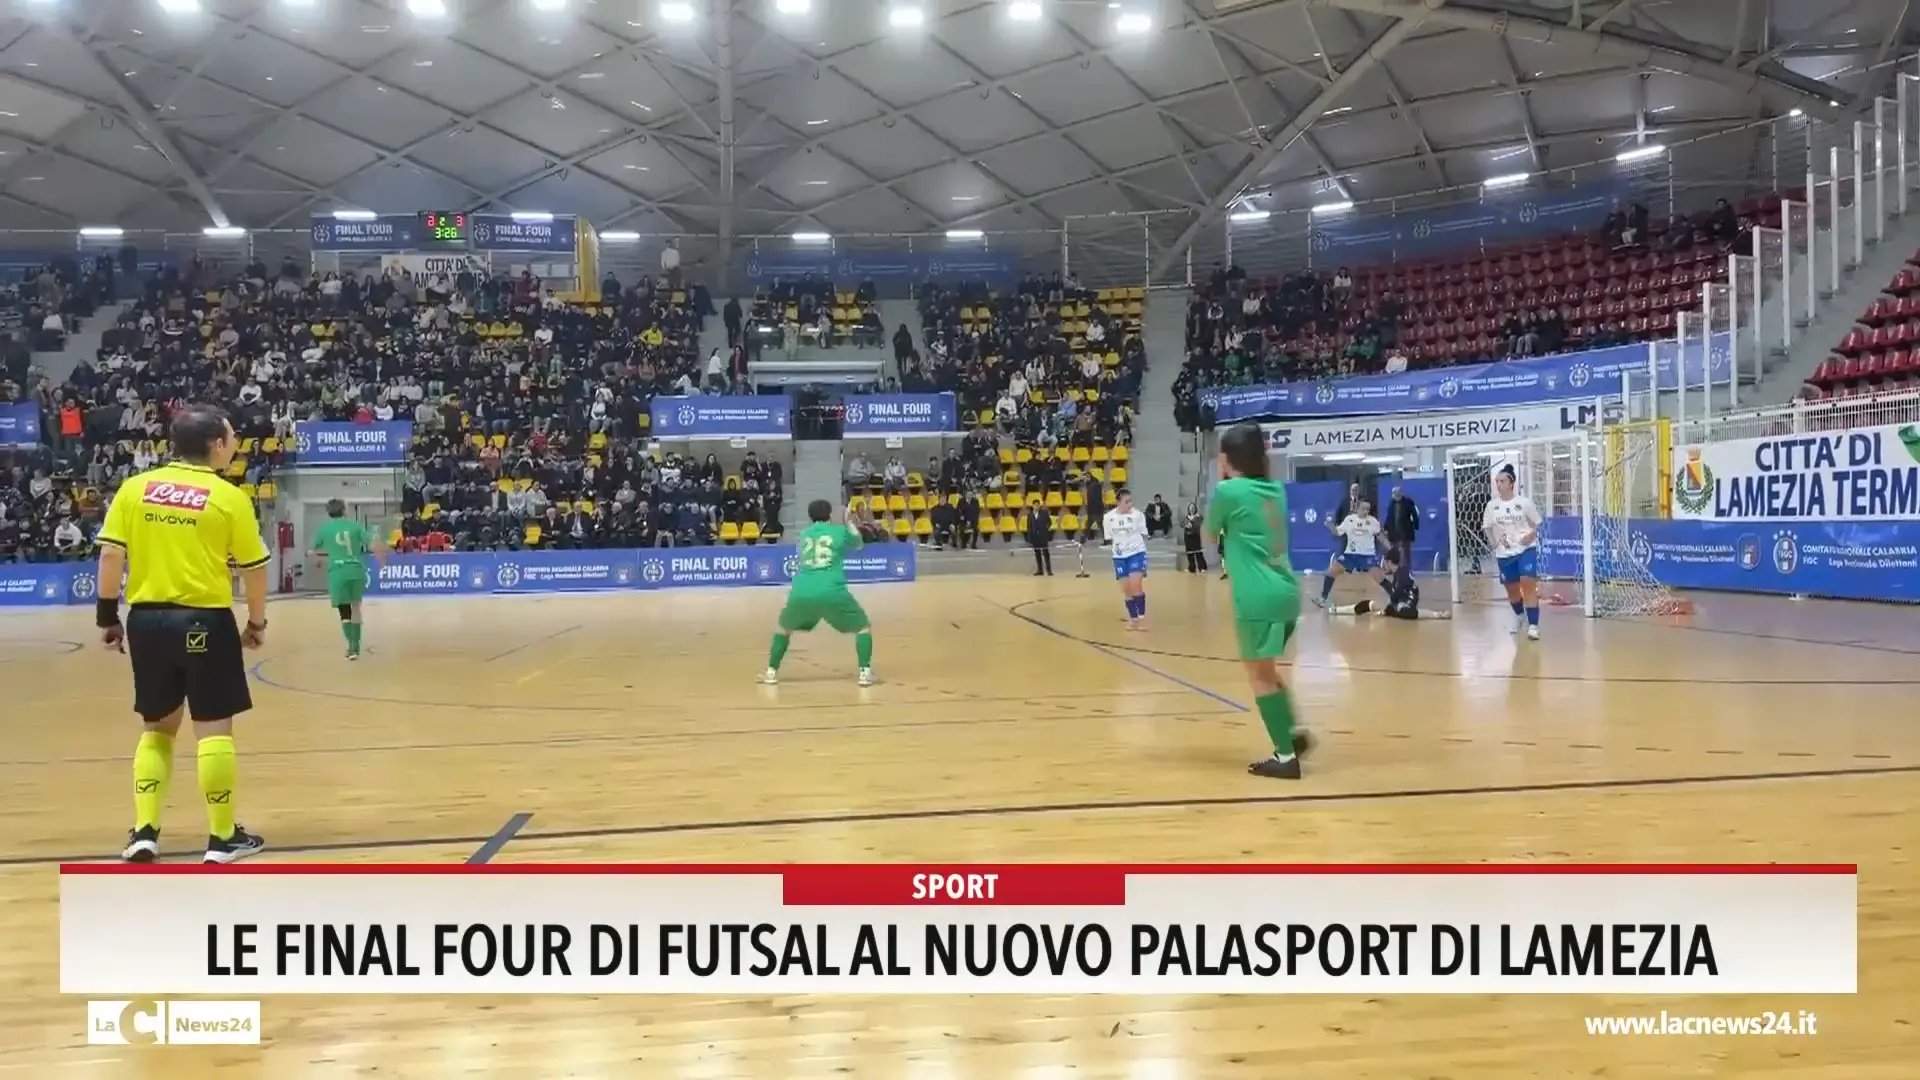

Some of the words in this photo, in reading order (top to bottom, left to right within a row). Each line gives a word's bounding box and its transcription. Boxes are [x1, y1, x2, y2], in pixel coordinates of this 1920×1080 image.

[335, 224, 364, 235] FINAL
[366, 224, 392, 234] FOUR
[495, 225, 523, 235] FINAL
[525, 226, 551, 236] FOUR
[868, 403, 900, 415] FINAL
[903, 402, 931, 414] FOUR
[317, 431, 352, 444] FINAL
[355, 430, 387, 443] FOUR
[1304, 427, 1384, 446] LAMEZIA
[1391, 417, 1516, 439] MULTISERVIZI
[1755, 434, 1842, 472] CITTA'
[1849, 432, 1881, 467] DI
[143, 483, 208, 507] Lete
[1714, 472, 1825, 518] LAMEZIA
[1832, 467, 1920, 516] TERM
[145, 512, 197, 527] GIVOVA
[335, 530, 353, 556] 4
[1872, 546, 1917, 556] CALABRIA
[671, 557, 710, 571] FINAL
[713, 556, 748, 570] FOUR
[1879, 557, 1917, 568] Dilettanti
[379, 564, 420, 578] FINAL
[423, 564, 460, 578] FOUR
